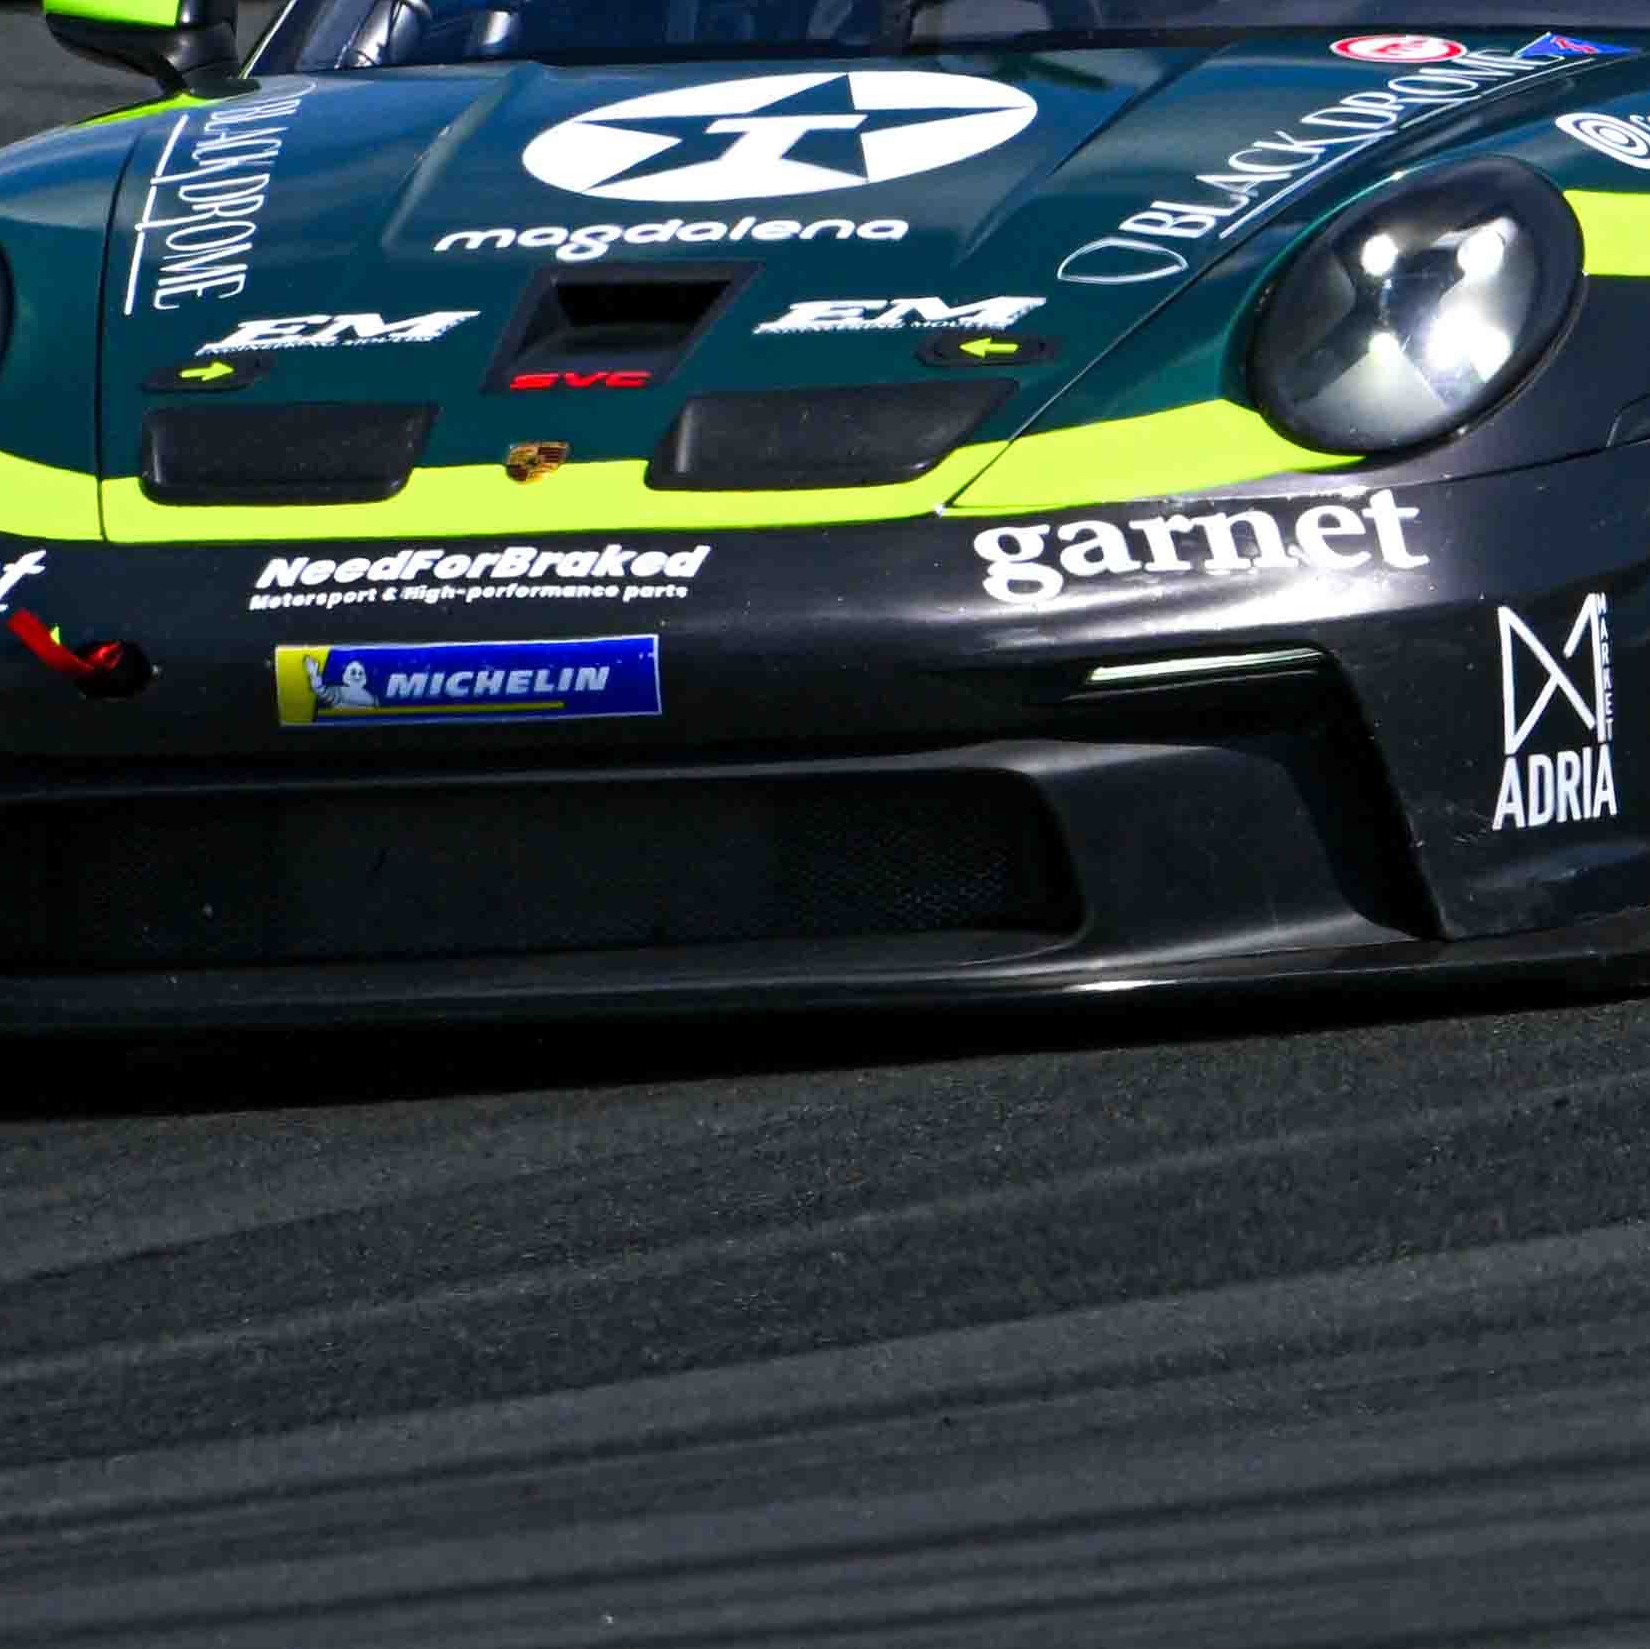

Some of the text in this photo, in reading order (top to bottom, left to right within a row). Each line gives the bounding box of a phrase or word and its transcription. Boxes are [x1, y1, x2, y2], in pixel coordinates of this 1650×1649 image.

[434, 217, 910, 263] magdalena
[255, 544, 711, 589] NeedForBraked
[973, 488, 1429, 606] garnet
[249, 586, 378, 610] Motorsport
[382, 588, 398, 602] &
[622, 584, 689, 603] parts
[386, 666, 611, 698] MICHELIN
[1598, 592, 1614, 742] MARKET
[1492, 743, 1618, 831] ADRIA
